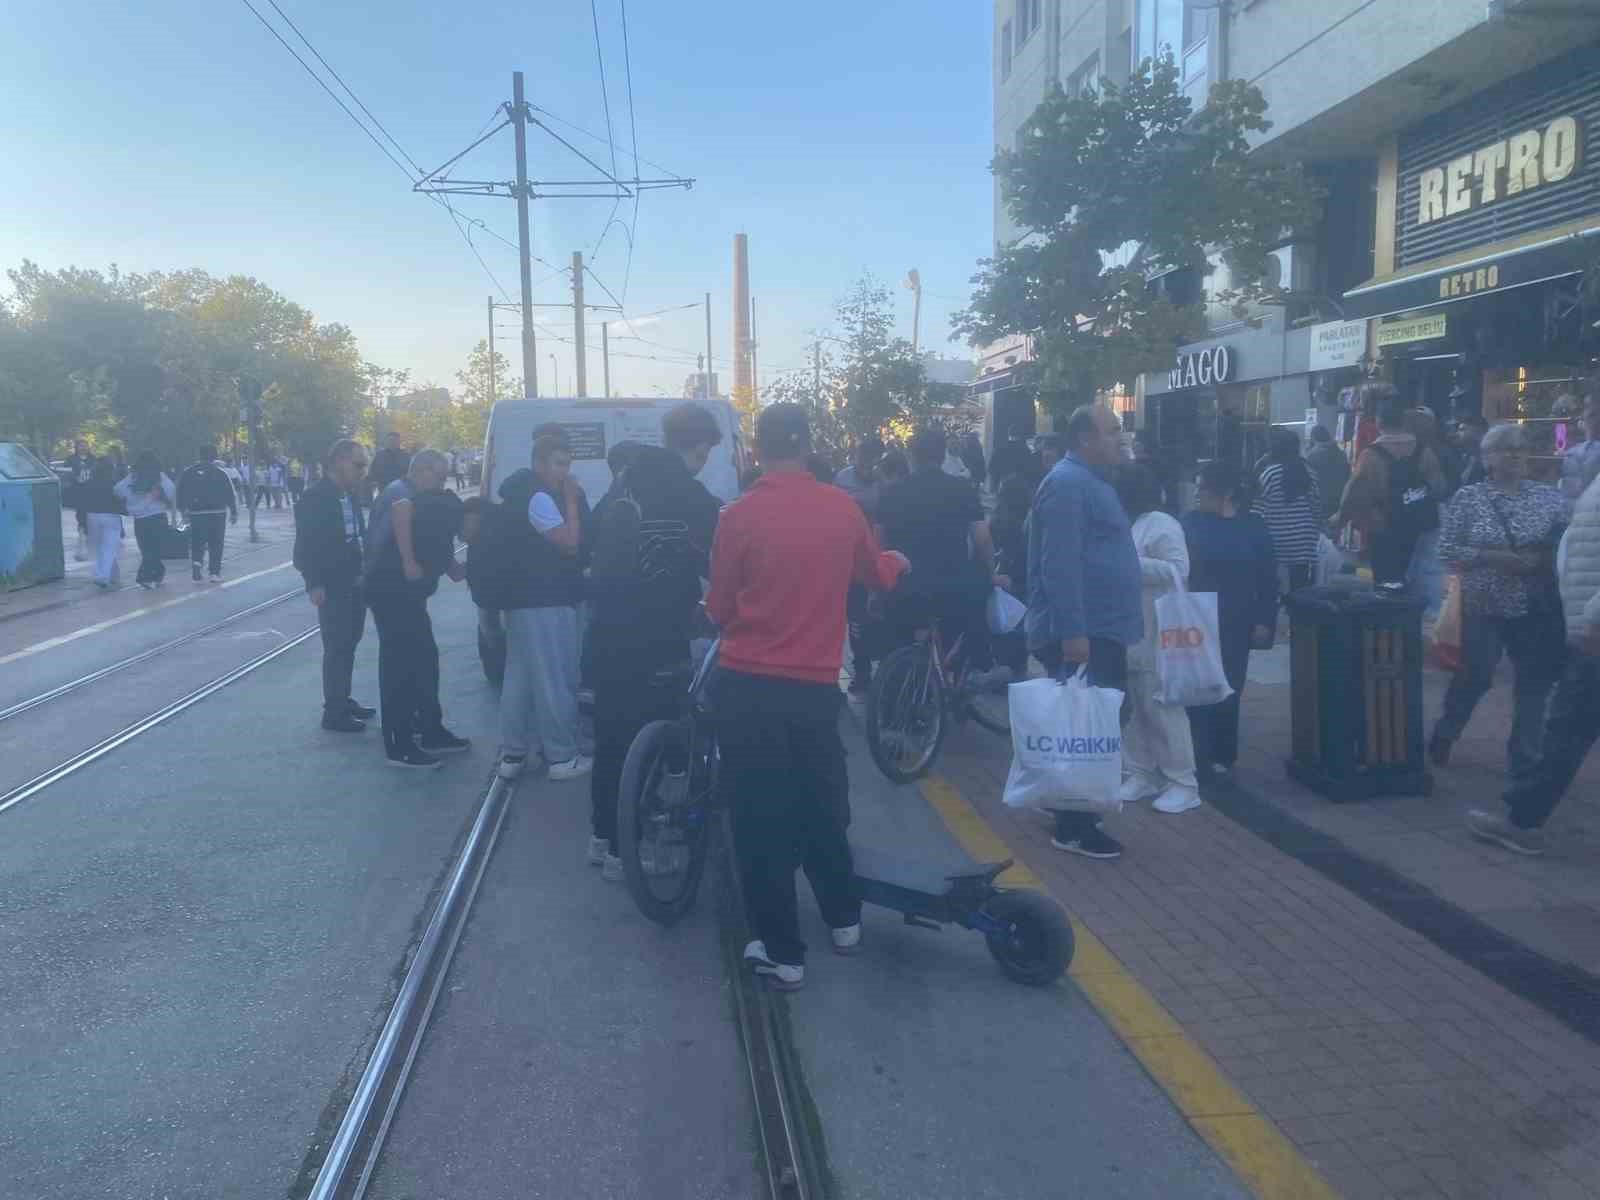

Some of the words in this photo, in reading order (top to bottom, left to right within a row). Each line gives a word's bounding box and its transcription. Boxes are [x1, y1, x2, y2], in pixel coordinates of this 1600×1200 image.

[1418, 115, 1577, 225] RETRO
[1439, 264, 1499, 297] RETRO
[1167, 345, 1229, 390] MAGO
[1026, 735, 1053, 752] LC
